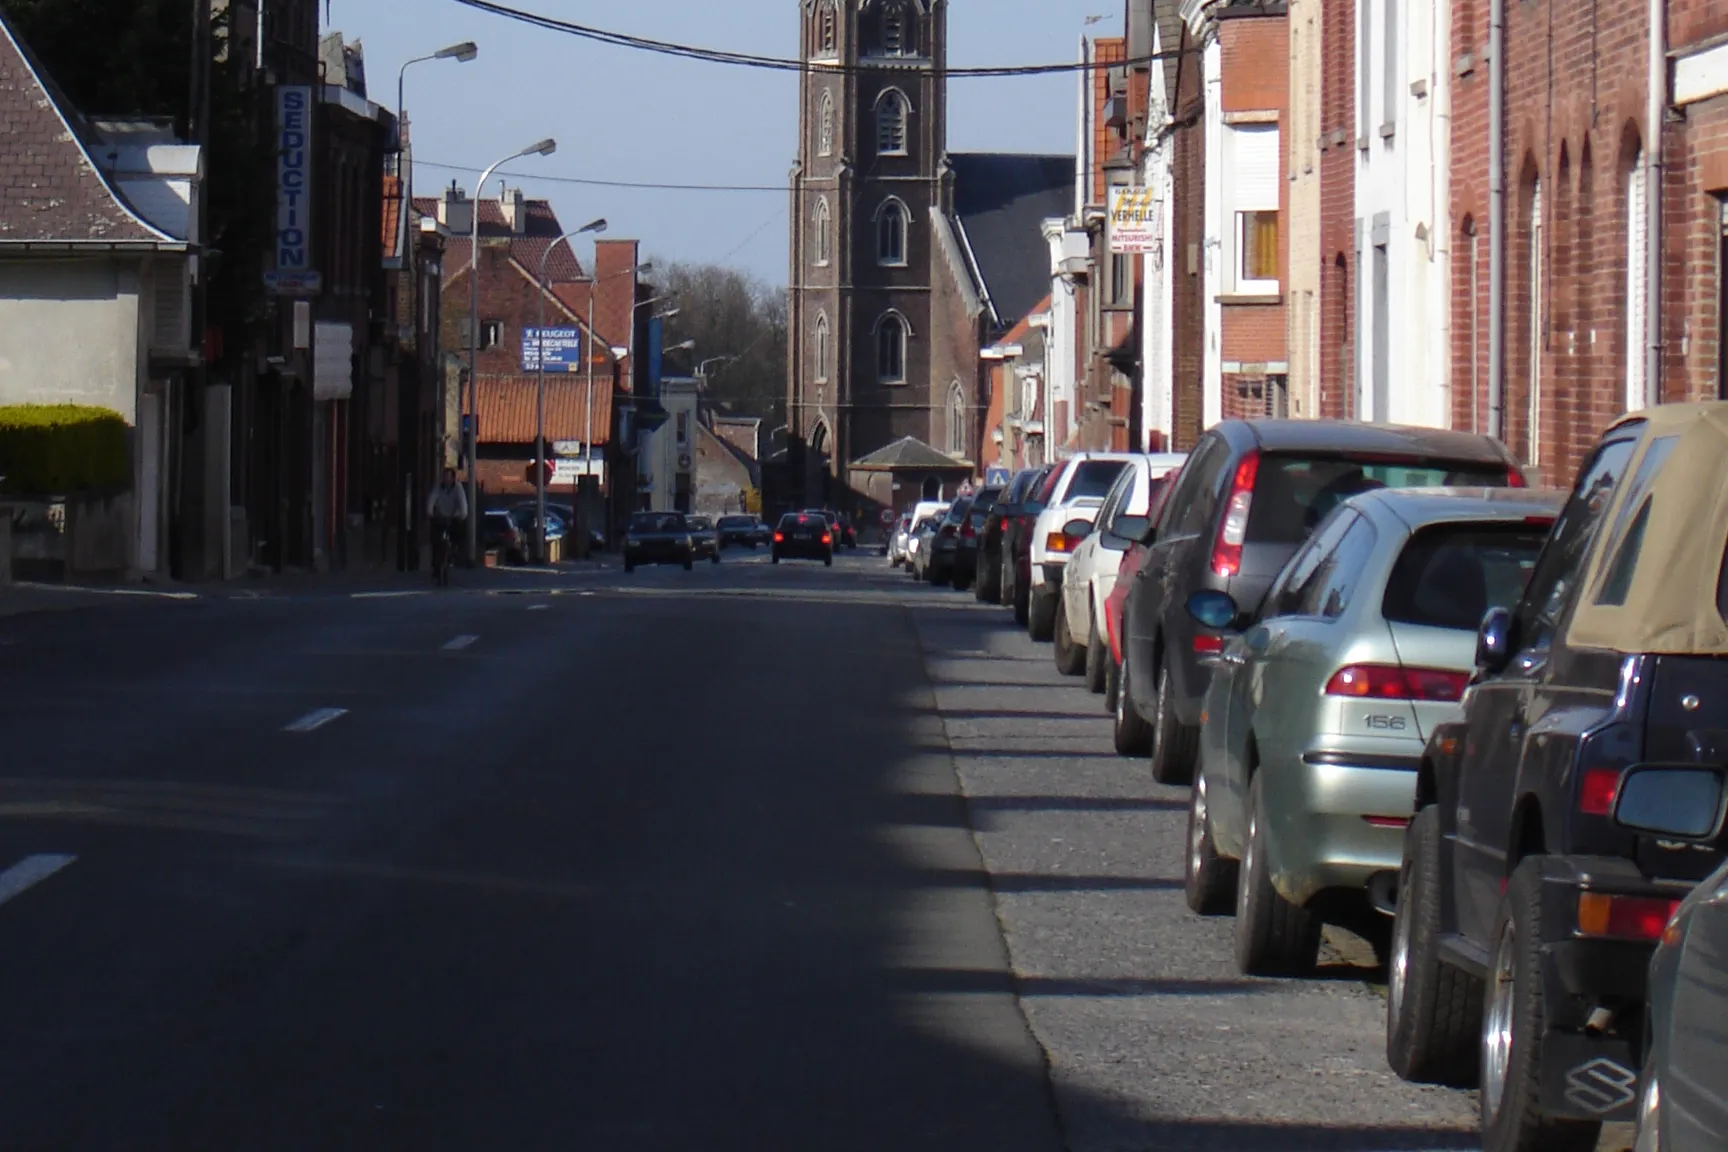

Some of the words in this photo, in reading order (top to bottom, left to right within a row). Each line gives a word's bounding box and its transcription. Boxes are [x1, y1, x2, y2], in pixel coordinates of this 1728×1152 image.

[282, 91, 304, 266] SEDUCTION
[1111, 210, 1153, 221] VERHELLE
[1112, 234, 1153, 242] MITSUBISHI
[1363, 714, 1406, 730] 156
